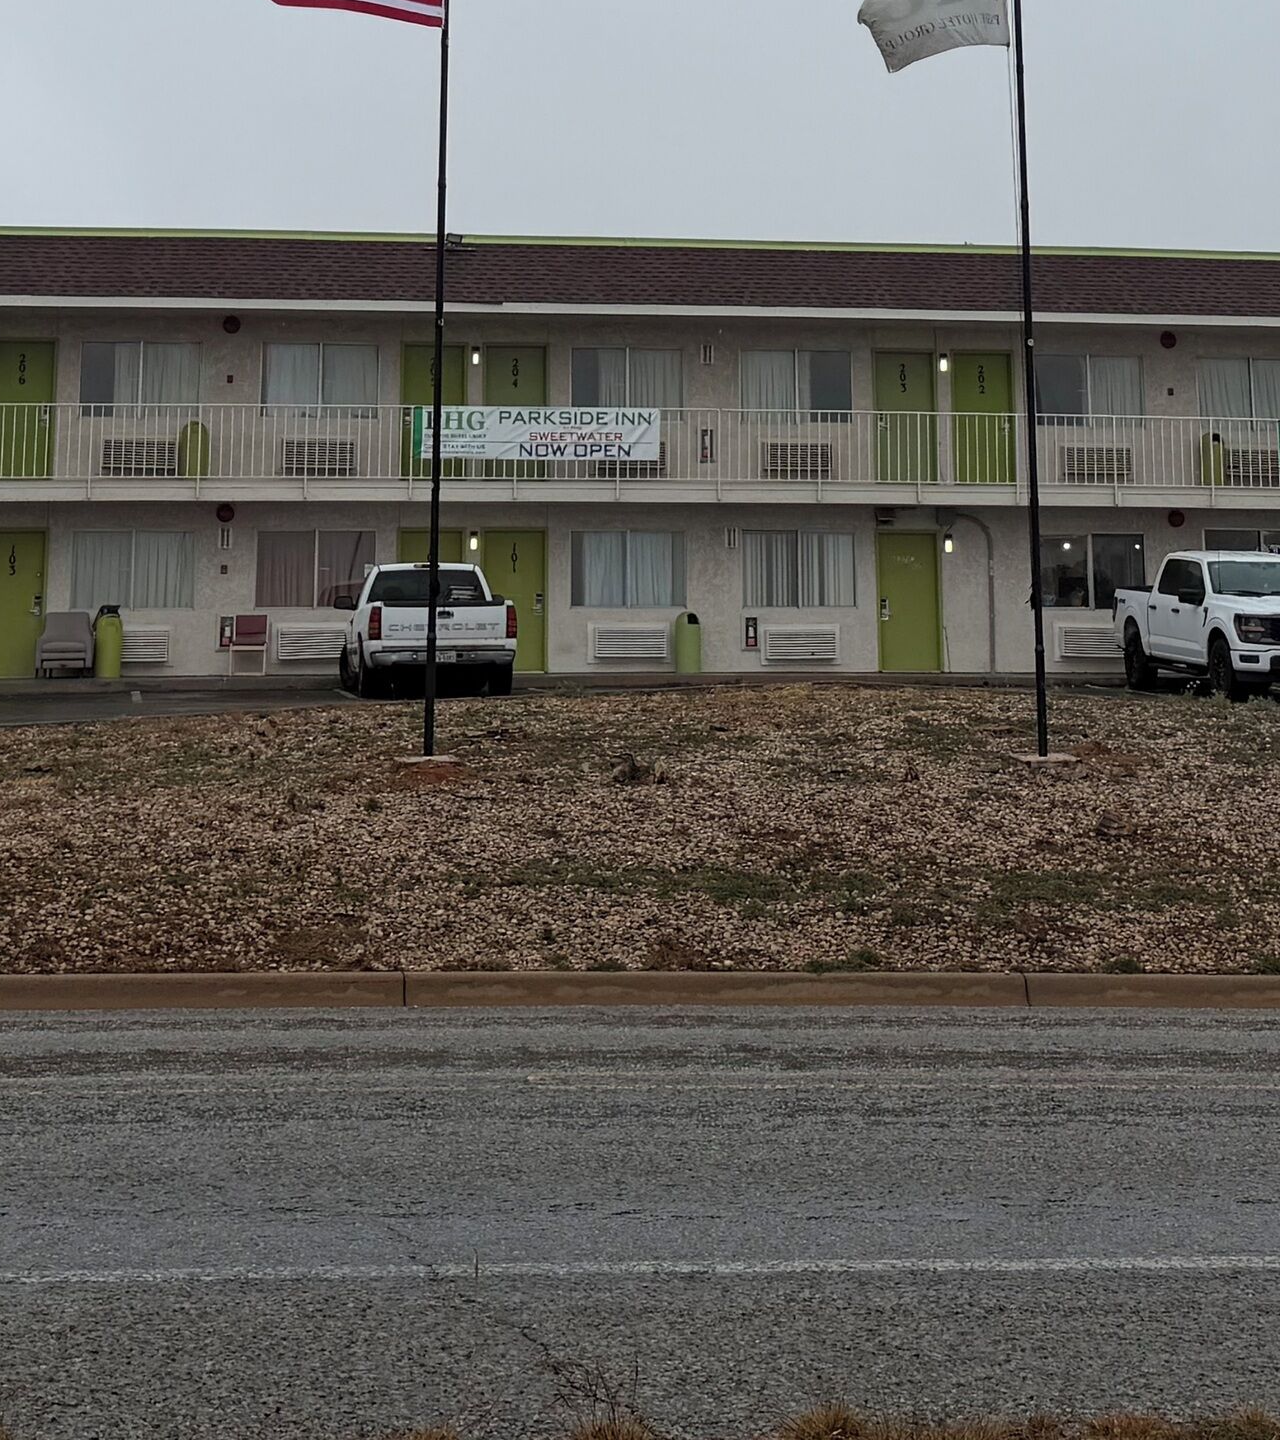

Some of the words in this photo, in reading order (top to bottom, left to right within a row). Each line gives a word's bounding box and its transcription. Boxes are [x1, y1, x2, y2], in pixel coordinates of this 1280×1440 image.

[18, 354, 26, 385] 206
[511, 358, 519, 388] 204
[898, 363, 907, 393] 203
[977, 365, 985, 394] 202
[498, 410, 609, 426] PARKSIDE
[615, 411, 652, 426] INN
[519, 443, 568, 458] NOW
[573, 444, 632, 458] OPEN
[528, 431, 623, 442] SWEETWATER
[9, 544, 17, 576] 103
[388, 622, 501, 632] CHEROLET
